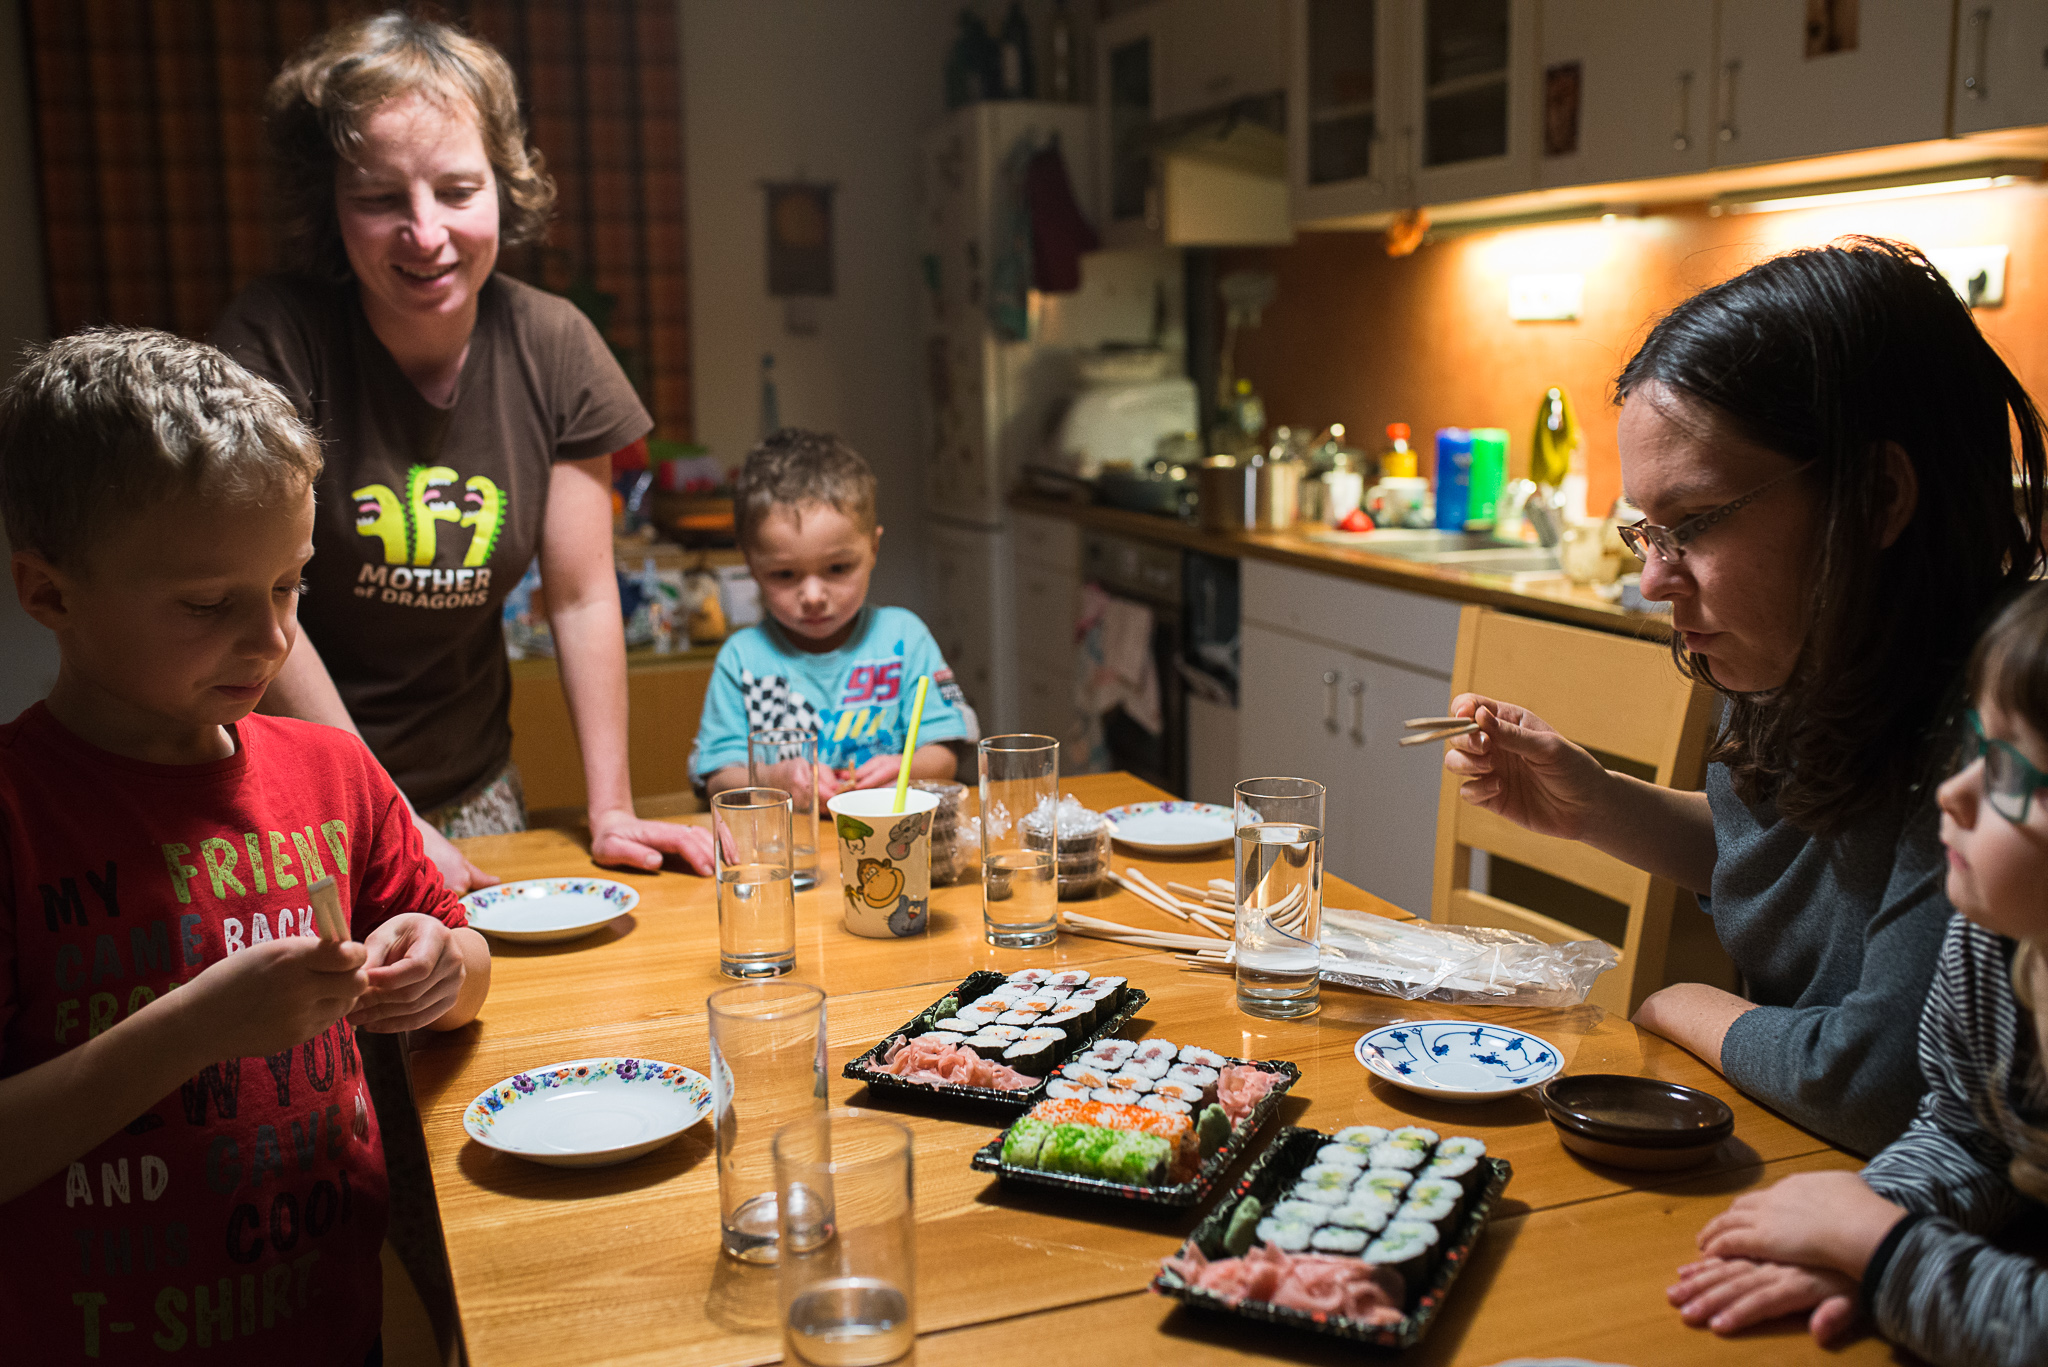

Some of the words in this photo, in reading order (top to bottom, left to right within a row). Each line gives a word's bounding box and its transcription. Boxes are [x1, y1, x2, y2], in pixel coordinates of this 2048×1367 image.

[358, 562, 492, 593] MOTHER
[381, 587, 490, 610] DRAGONS
[842, 661, 903, 705] 95
[38, 860, 120, 932] MY
[161, 819, 348, 904] FRIEND
[54, 913, 203, 992] CAME
[223, 904, 318, 957] BACK
[66, 1155, 169, 1208] AND
[206, 1104, 344, 1195] GAVE
[73, 1220, 190, 1277] THIS
